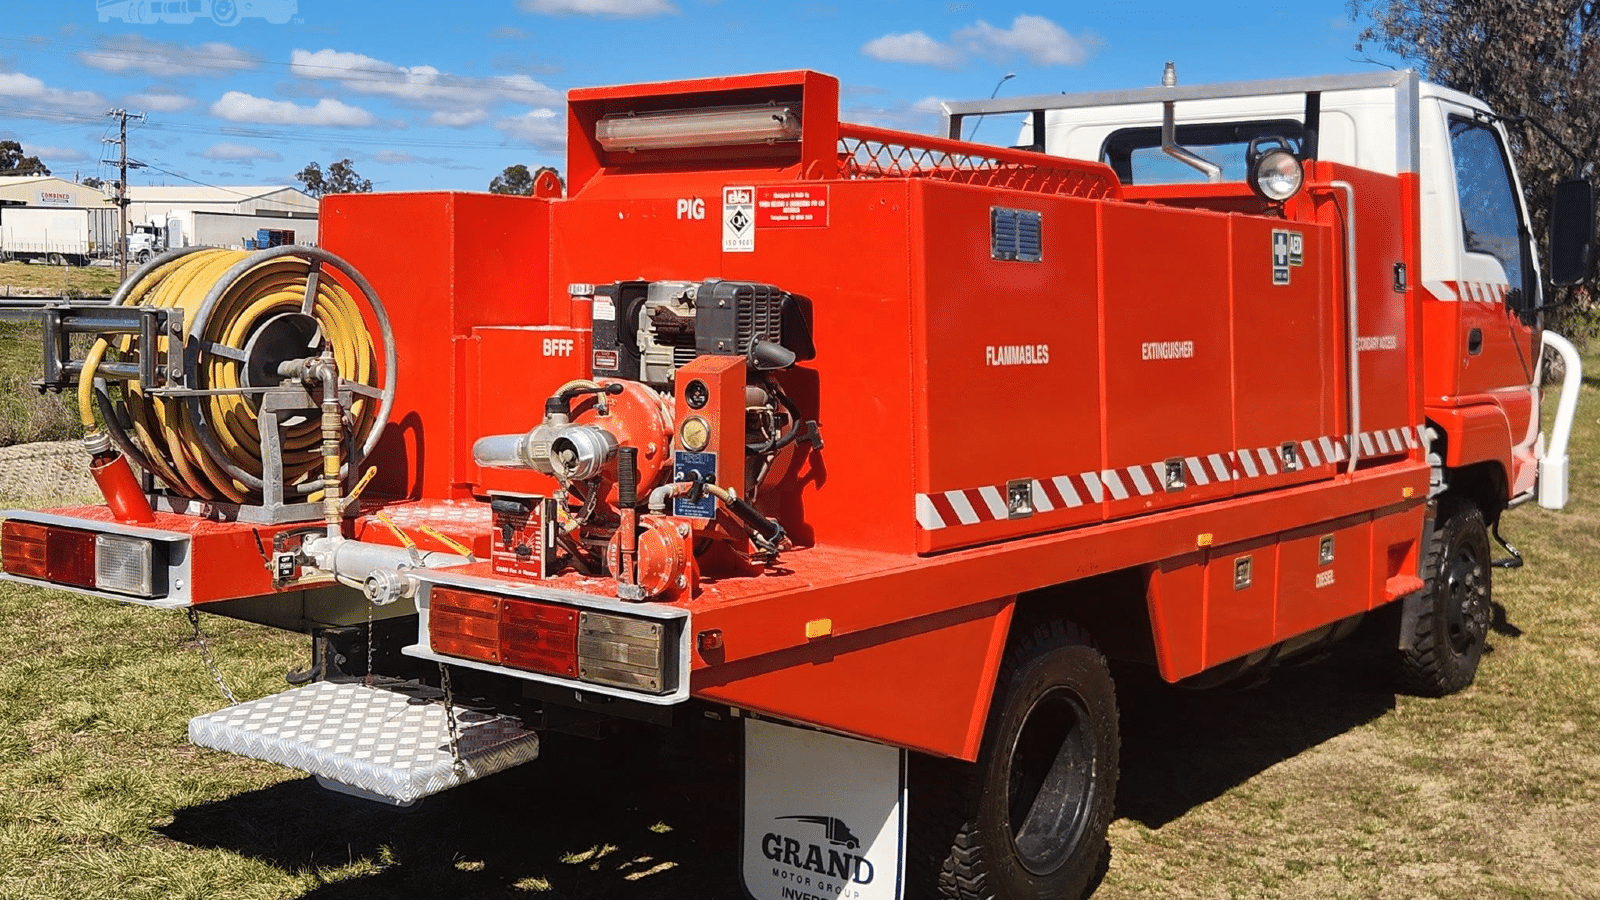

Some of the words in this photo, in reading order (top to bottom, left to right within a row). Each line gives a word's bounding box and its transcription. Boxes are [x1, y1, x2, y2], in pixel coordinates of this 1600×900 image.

[677, 198, 705, 220] PIG
[1290, 235, 1302, 255] AED
[542, 338, 574, 357] BFFF
[986, 344, 1050, 366] FLAMMABLES
[1141, 340, 1195, 361] EXTINGUISHER
[1315, 570, 1334, 588] DIESEL
[761, 832, 875, 886] GRAND
[772, 867, 812, 887] MOTOR
[817, 880, 860, 900] GROUP
